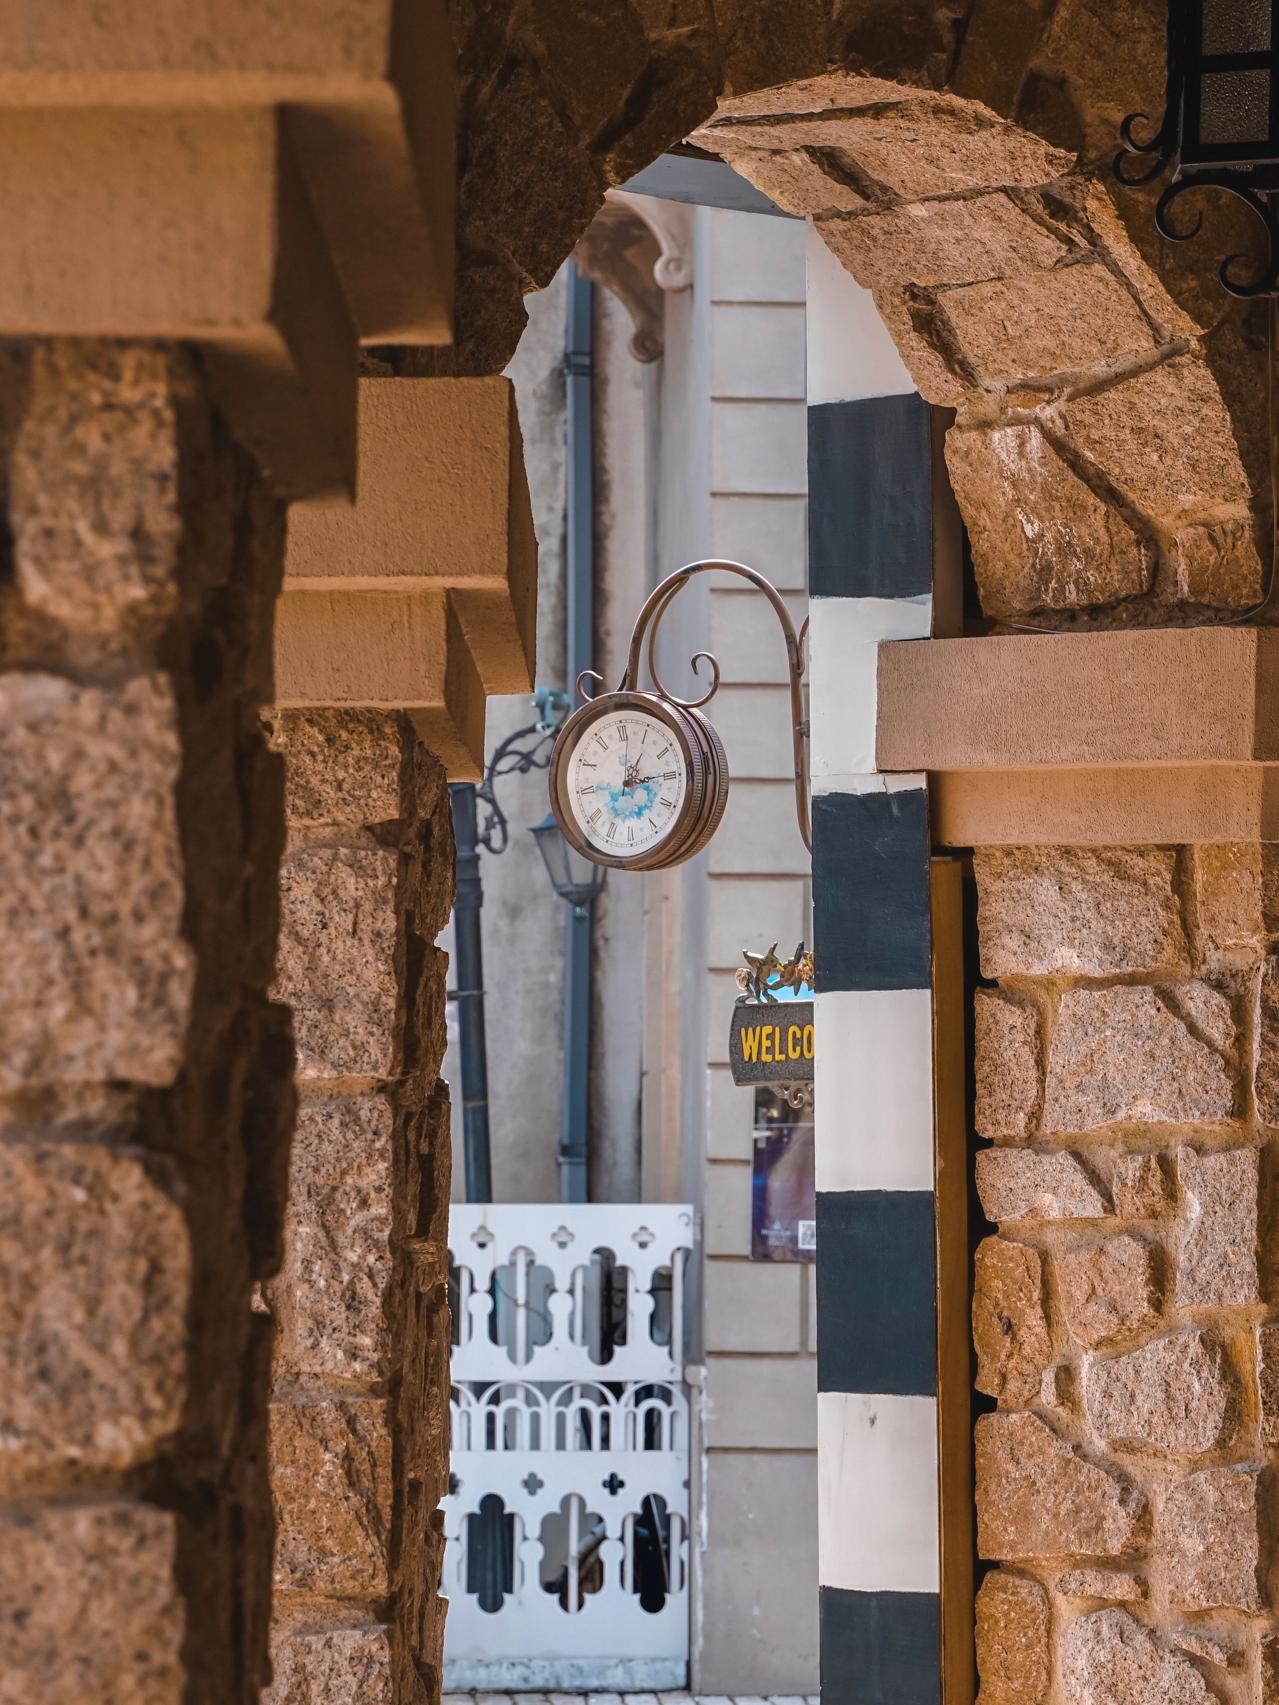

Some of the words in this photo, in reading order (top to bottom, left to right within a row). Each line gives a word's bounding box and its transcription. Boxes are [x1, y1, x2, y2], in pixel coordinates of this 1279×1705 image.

[616, 725, 629, 742] XII
[641, 729, 648, 745] I
[656, 747, 670, 760] II
[582, 759, 598, 771] X
[663, 771, 677, 781] III
[648, 817, 658, 832] V
[741, 1024, 814, 1063] WELCO
